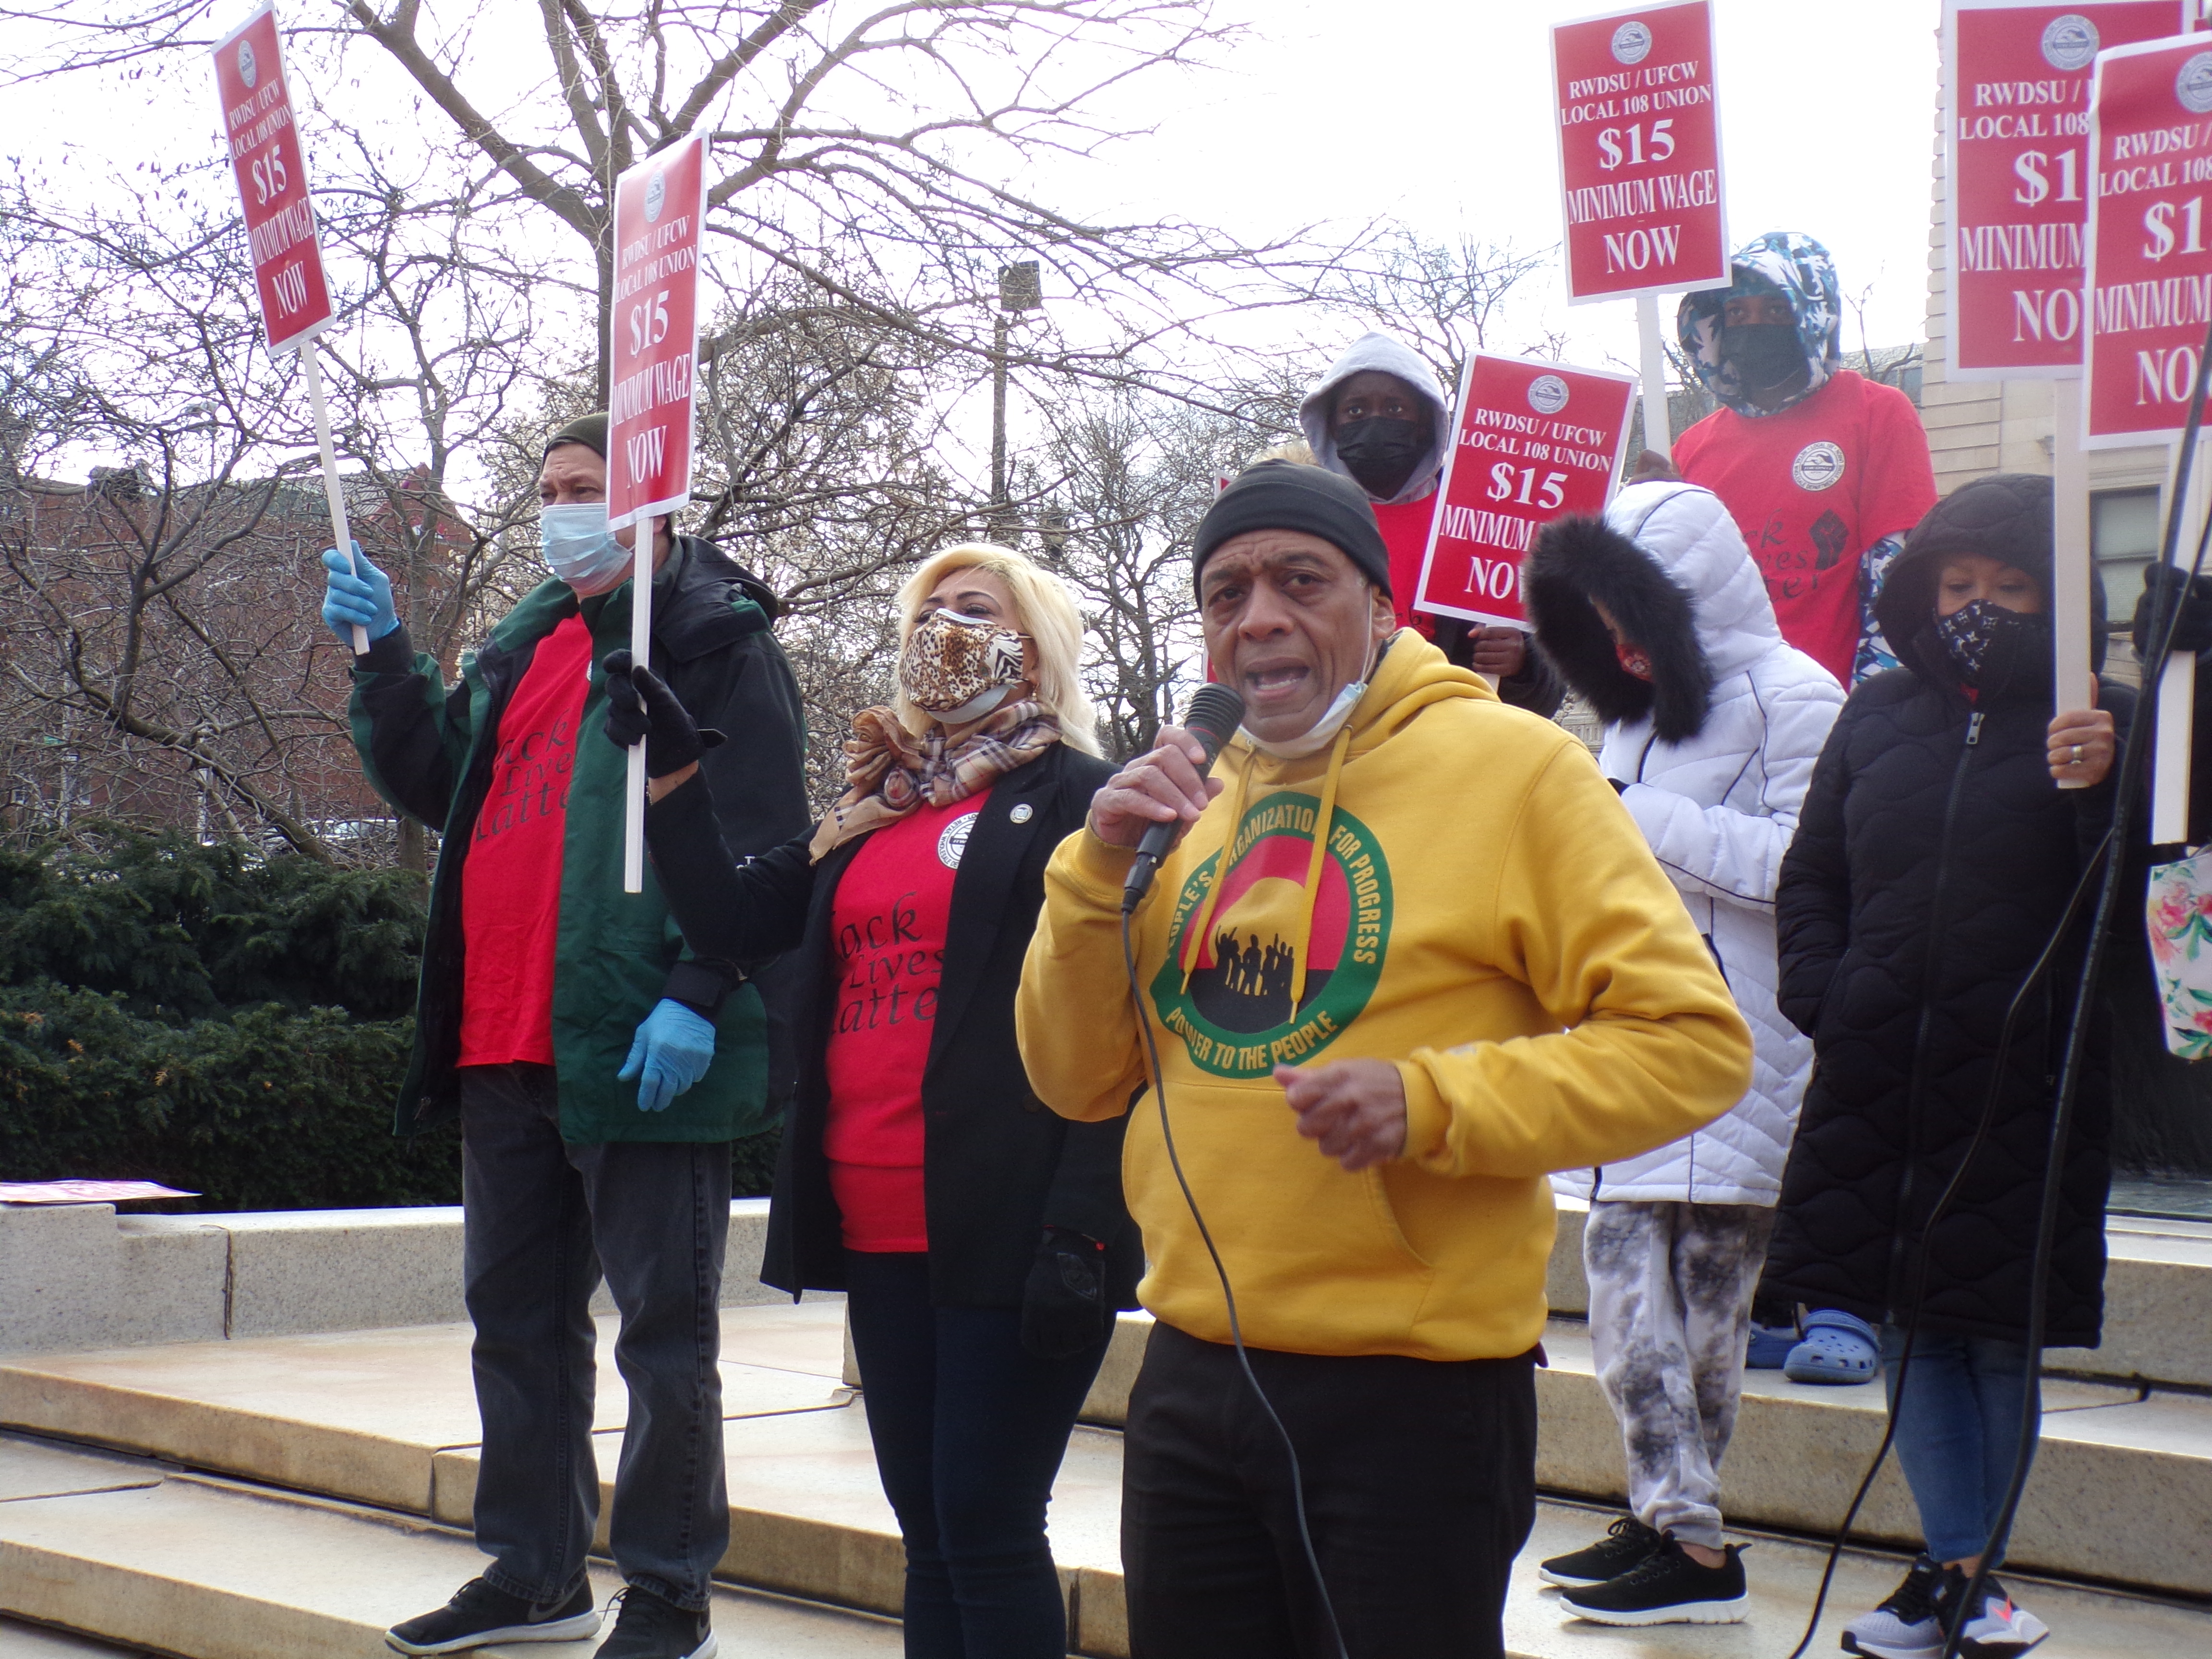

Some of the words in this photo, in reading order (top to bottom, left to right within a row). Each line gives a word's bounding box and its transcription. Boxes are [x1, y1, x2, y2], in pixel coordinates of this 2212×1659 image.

[229, 96, 256, 131] RWDSU
[258, 78, 279, 109] UFCW
[1561, 100, 1620, 126] LOCAL
[1623, 95, 1649, 115] 108
[1653, 84, 1713, 110] UNION
[1569, 71, 1632, 99] RWDSU
[1635, 70, 1642, 88] /
[1645, 60, 1699, 87] UFCW
[1975, 80, 2067, 106] RWDSU
[2072, 80, 2081, 102] /
[230, 129, 257, 160] LOCAL
[266, 102, 292, 135] UNION
[1598, 118, 1675, 171] $15
[1959, 114, 2048, 140] LOCAL
[2053, 112, 2089, 135] 108
[2114, 124, 2200, 161] RWDSU
[252, 144, 287, 206] $15
[1567, 178, 1656, 225] MINIMUM
[1658, 168, 1717, 210] WAGE
[2014, 148, 2082, 206] $1
[2099, 162, 2176, 197] LOCAL
[249, 211, 290, 268] MINIMUM
[285, 197, 313, 246] WAGE
[622, 233, 652, 269] RWDSU
[657, 215, 690, 248] UFCW
[1604, 224, 1681, 274] NOW
[1960, 223, 2087, 272] MINIMUM
[2142, 196, 2206, 262] $1
[272, 261, 307, 319] NOW
[615, 269, 642, 303] LOCAL
[660, 244, 696, 278] UNION
[630, 289, 669, 358] $15
[2013, 288, 2084, 342] NO
[2095, 274, 2212, 335] MINIMUM
[612, 366, 654, 428] MINIMUM
[656, 353, 690, 406] WAGE
[2136, 345, 2205, 405] NO
[1458, 429, 1520, 456] LOCAL
[1523, 441, 1550, 460] 108
[1553, 447, 1613, 473] UNION
[1474, 408, 1539, 435] RWDSU
[1541, 421, 1550, 436] /
[1552, 422, 1607, 447] UFCW
[626, 426, 666, 489] NOW
[1487, 461, 1568, 509] $15
[1440, 504, 1536, 552] MINIMUM
[498, 709, 570, 764] ack
[500, 753, 571, 797] Live
[1216, 804, 1319, 866] RGANIZATIO
[1328, 825, 1362, 860] FOR
[1350, 854, 1381, 964] PROGRESS
[840, 891, 922, 959] ack
[840, 983, 938, 1034] atte
[1166, 1007, 1213, 1061] POWER
[1213, 1043, 1236, 1070] TO
[1238, 1044, 1268, 1070] THE
[1270, 1010, 1339, 1064] PEOPLE
